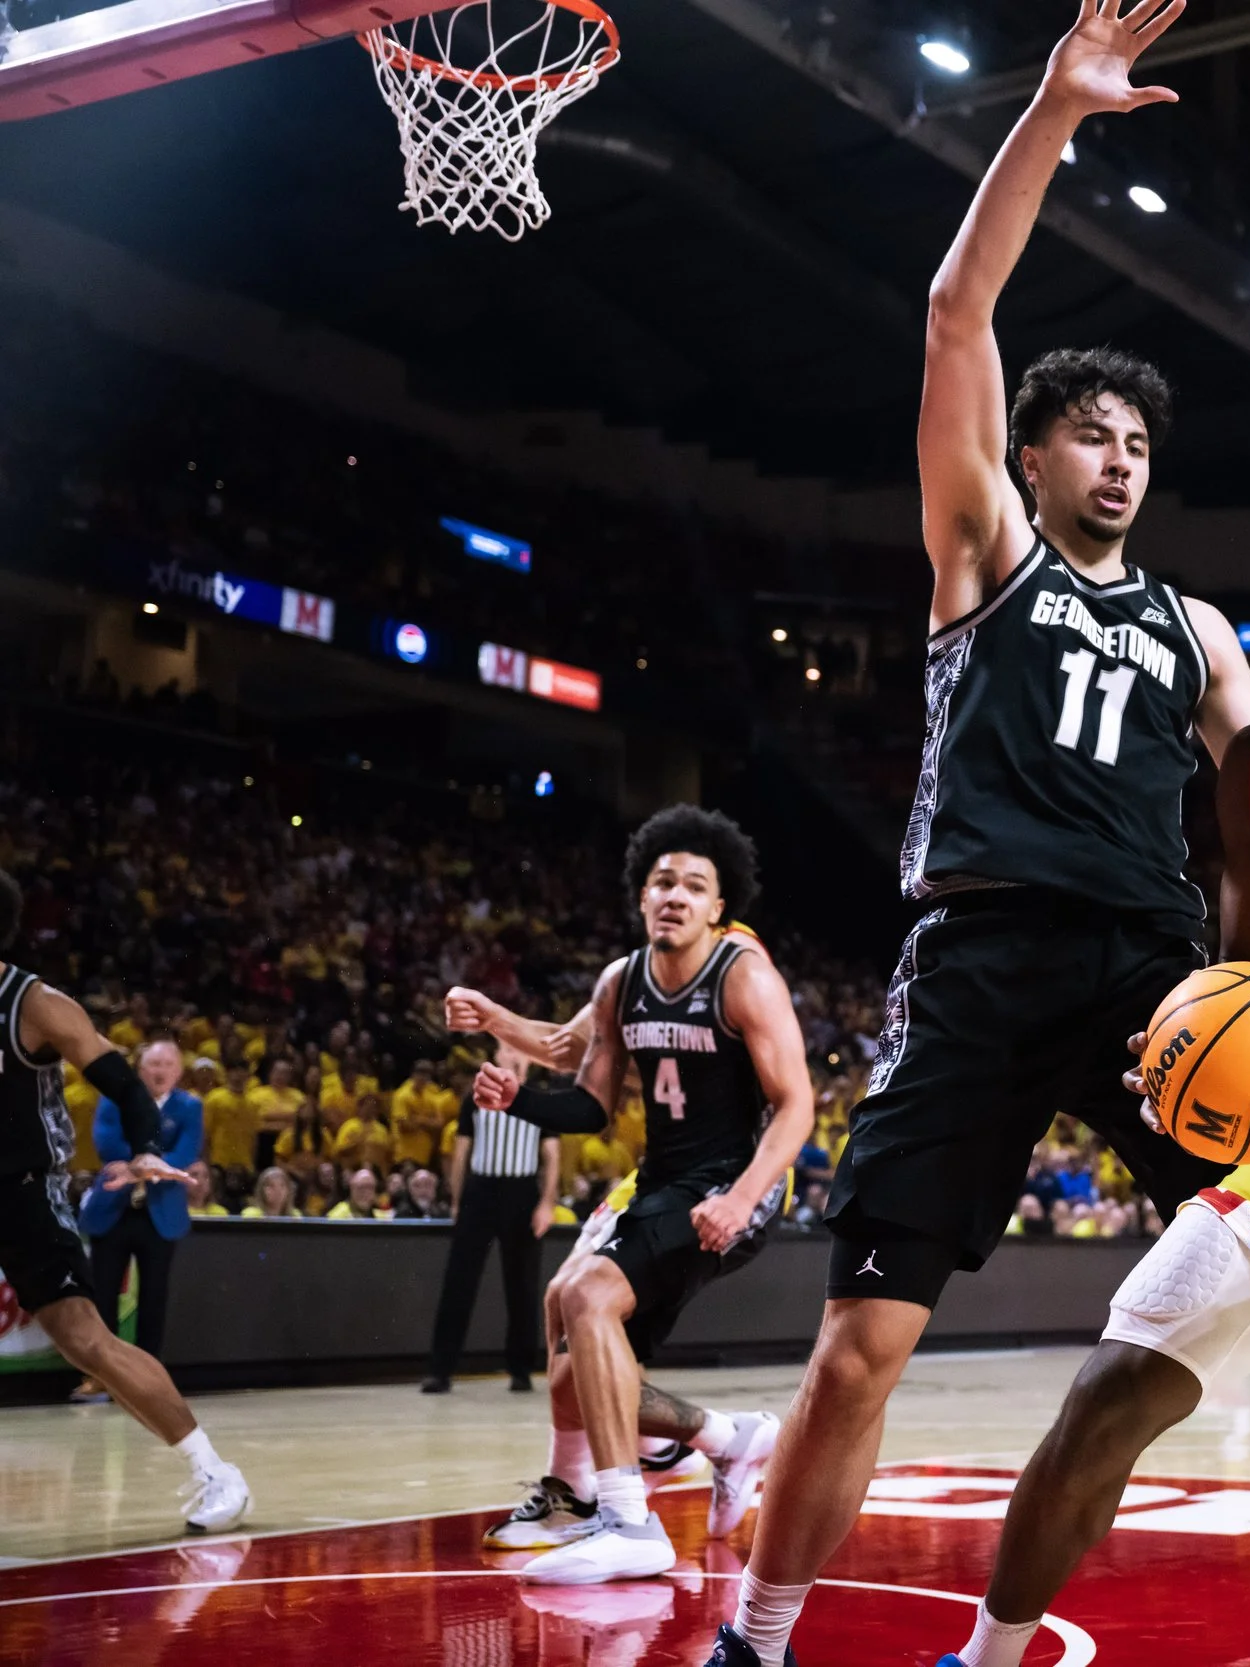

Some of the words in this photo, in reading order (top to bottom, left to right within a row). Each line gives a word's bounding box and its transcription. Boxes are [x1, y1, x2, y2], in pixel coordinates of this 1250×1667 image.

[148, 559, 245, 614] xfinity
[1030, 590, 1177, 691] GEORGETOWN
[1053, 647, 1138, 766] 11
[622, 1021, 717, 1053] GEORGETOWN
[654, 1057, 687, 1120] 4
[1185, 1098, 1235, 1147] M
